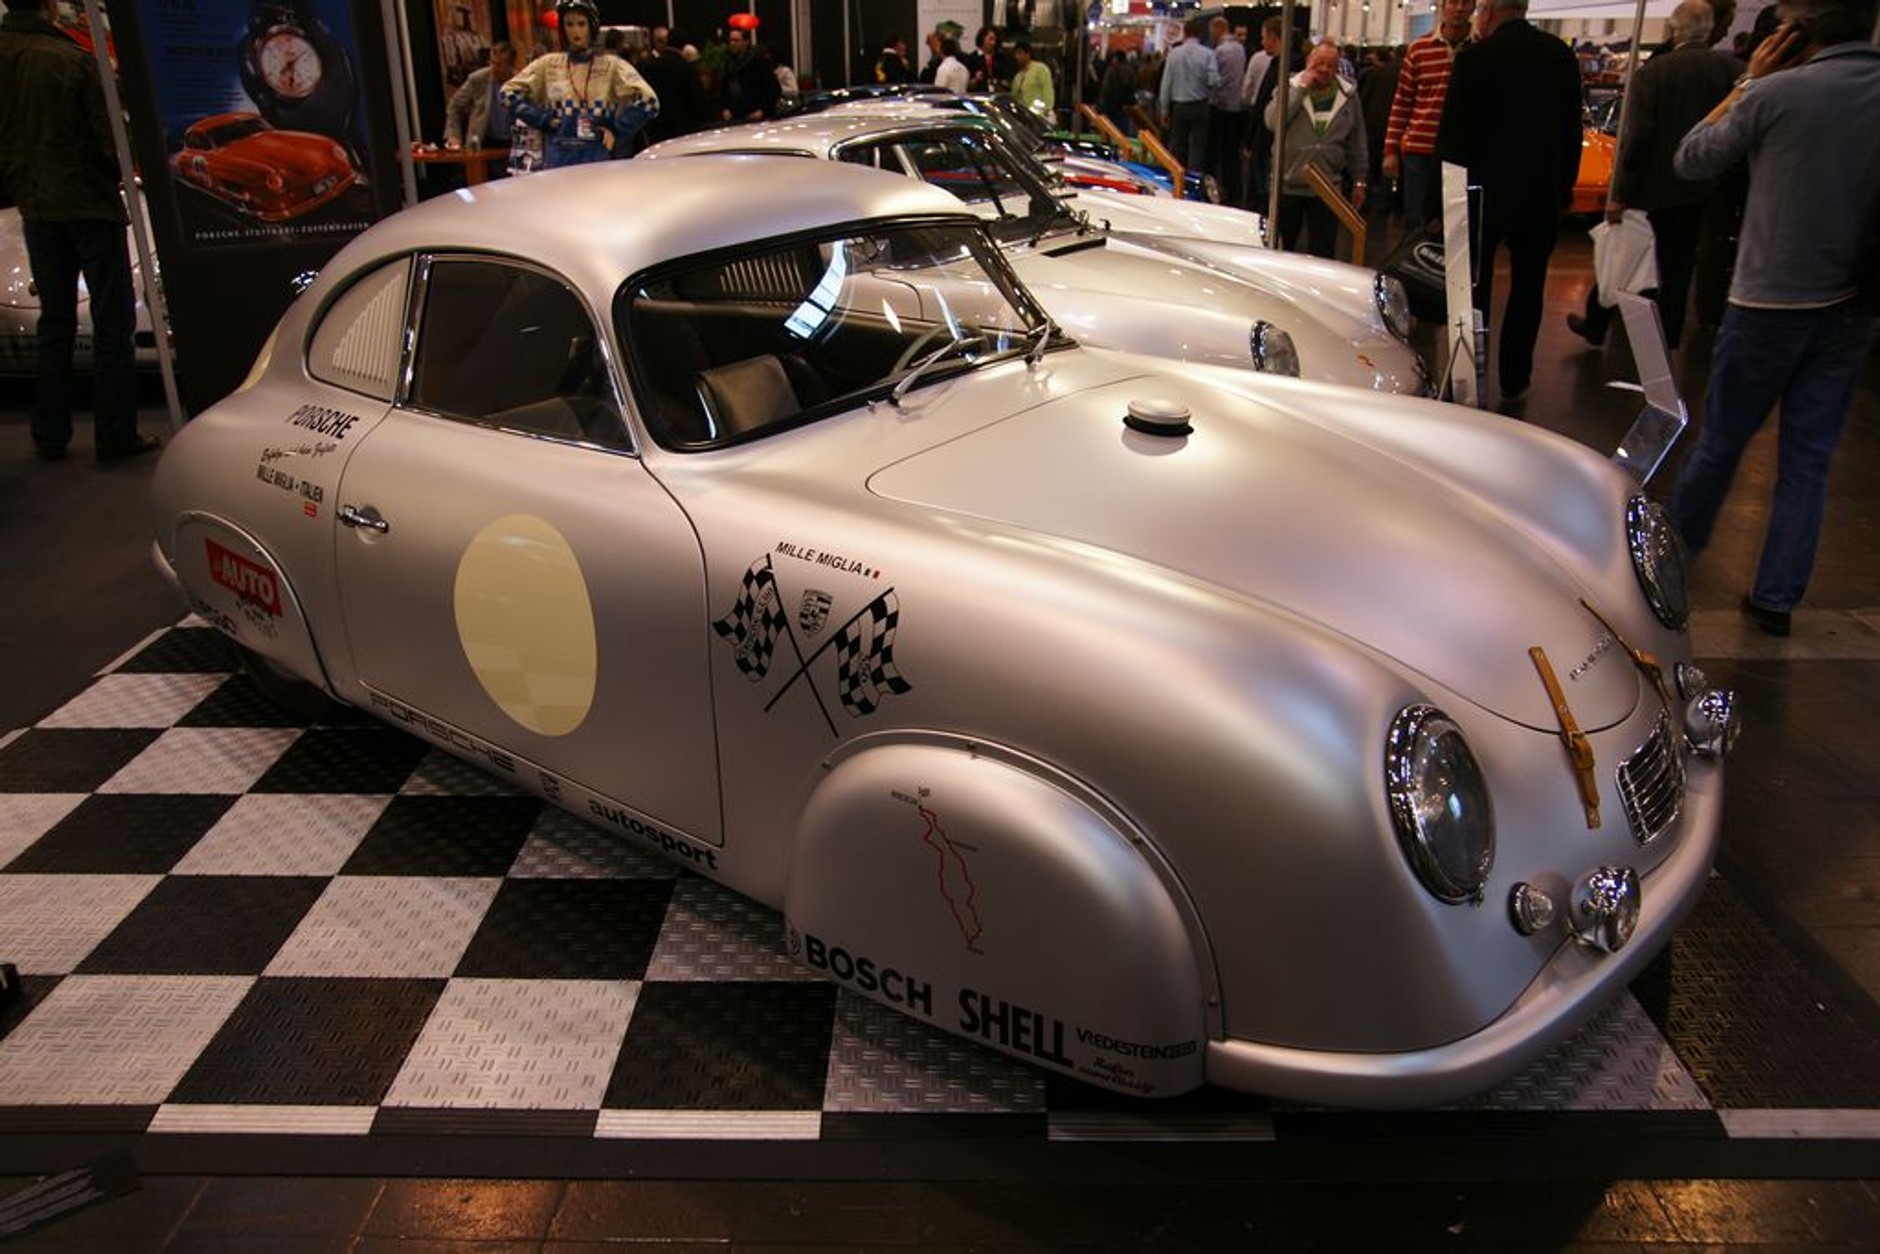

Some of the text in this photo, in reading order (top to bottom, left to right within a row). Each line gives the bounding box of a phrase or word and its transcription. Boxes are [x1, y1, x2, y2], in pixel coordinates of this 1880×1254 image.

[285, 404, 359, 439] PORSCHE
[221, 554, 275, 606] AUTO
[775, 541, 863, 575] MILLE MIGLIA
[369, 691, 719, 870] PORSCHE autosport
[805, 933, 1166, 1069] BOSCH SHELL VREDESTEIN
